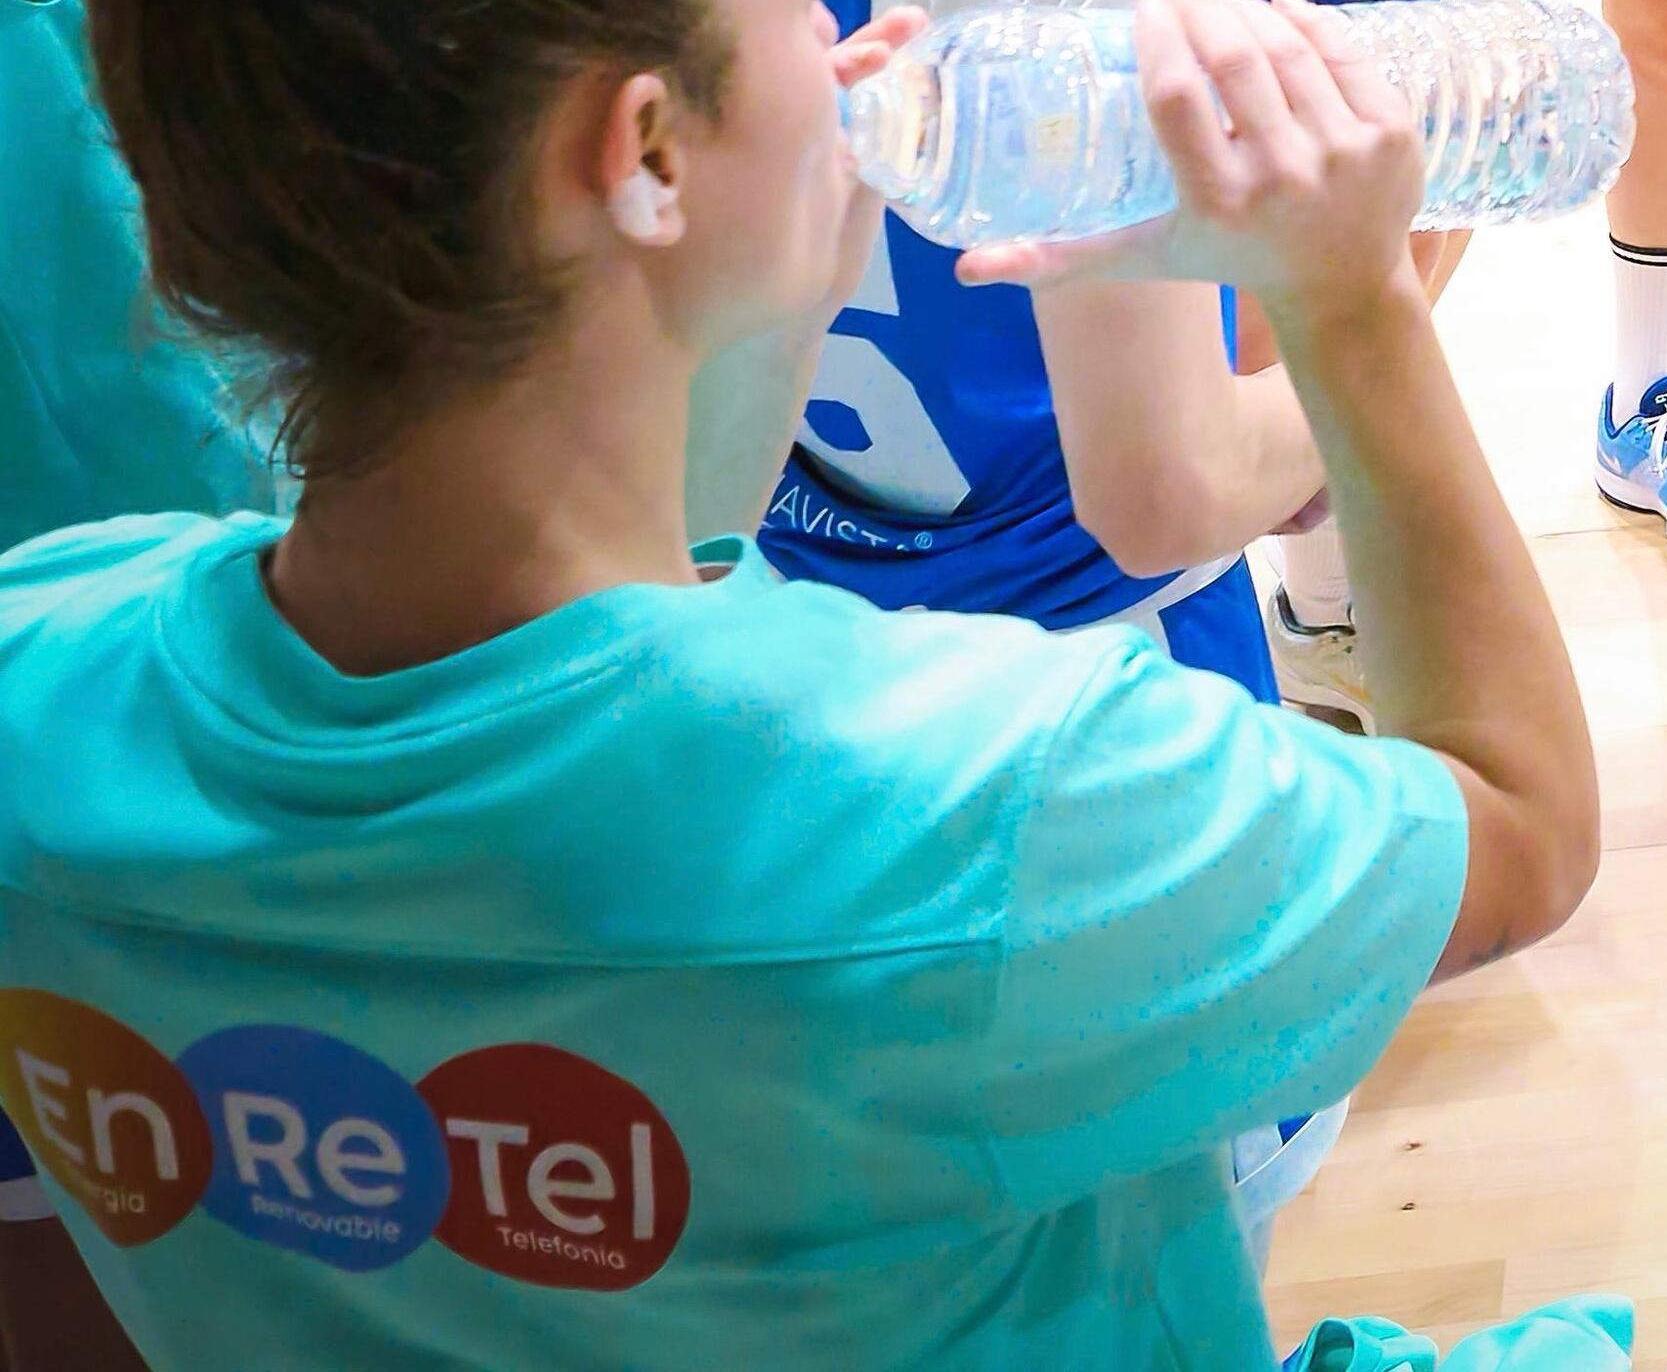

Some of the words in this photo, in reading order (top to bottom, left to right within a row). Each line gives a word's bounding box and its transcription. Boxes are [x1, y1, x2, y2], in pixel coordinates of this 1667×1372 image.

[15, 1046, 180, 1182] En
[222, 1091, 407, 1208] Re
[446, 1115, 656, 1240] Tel
[251, 1193, 401, 1244] Renovable
